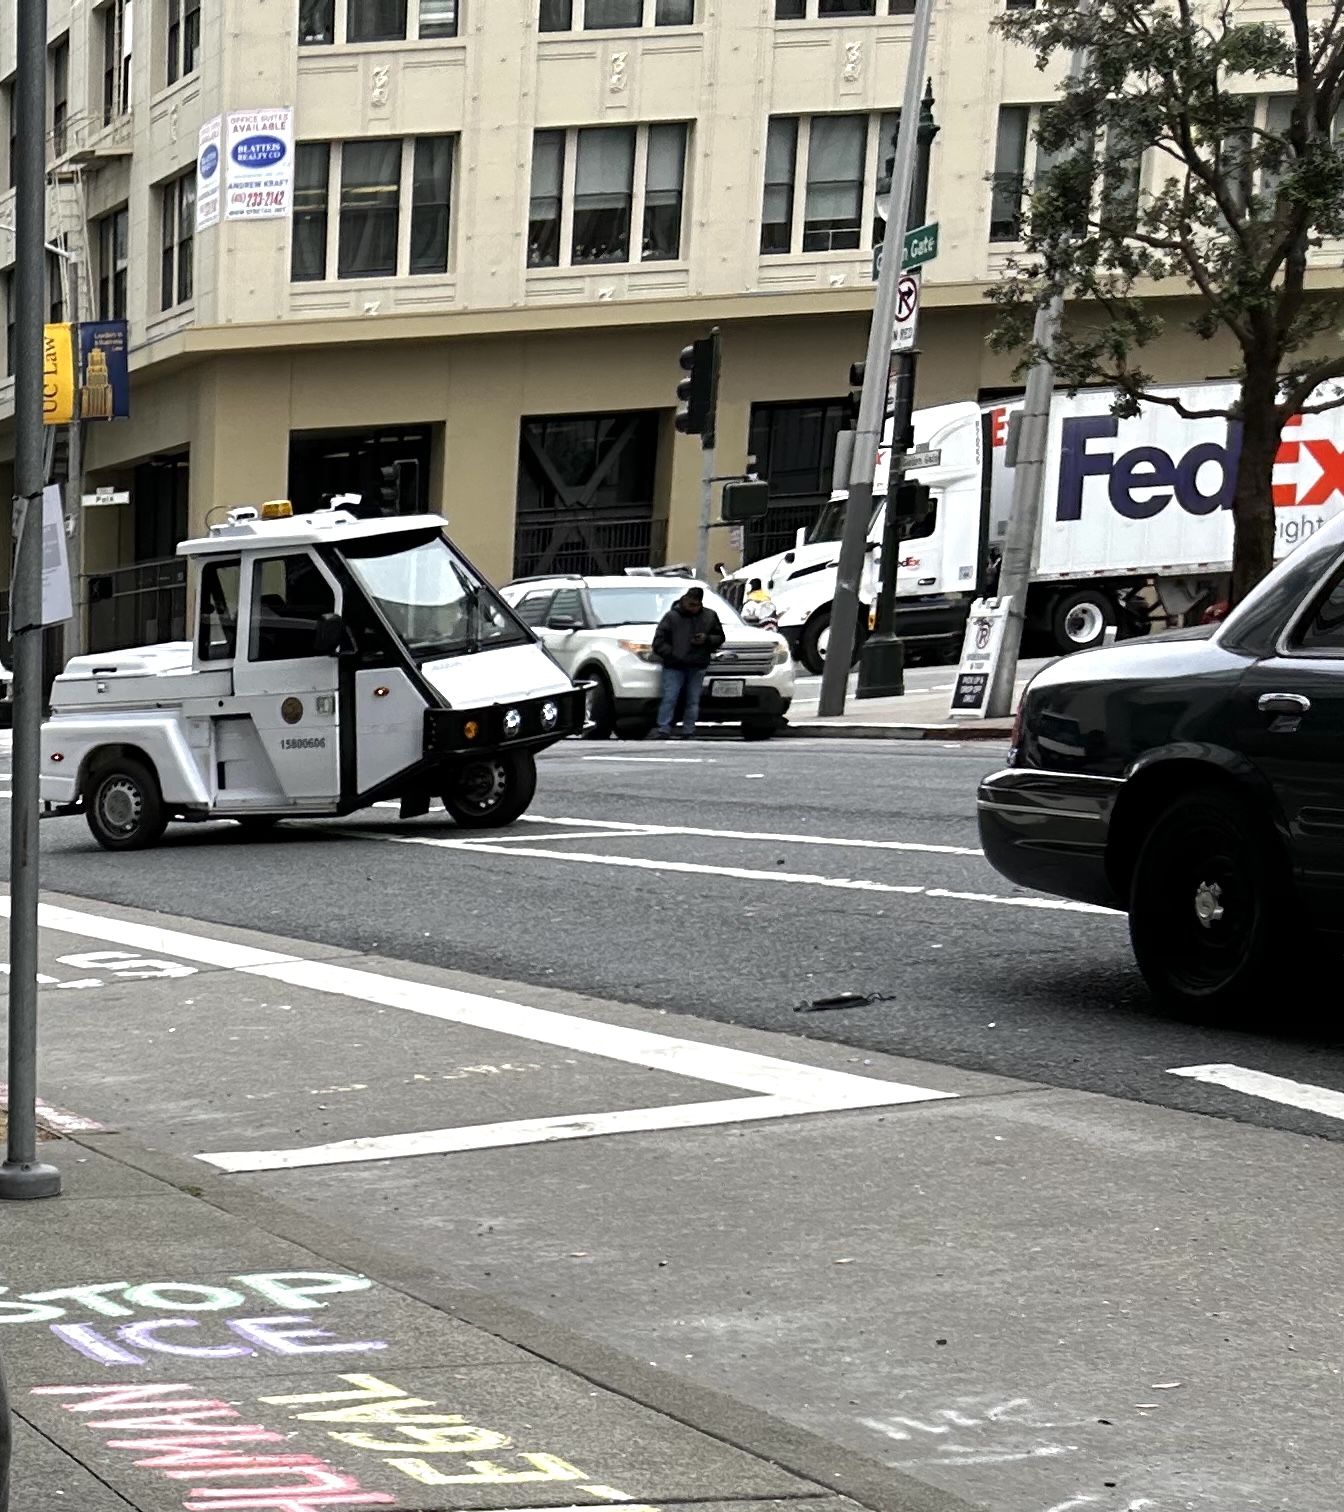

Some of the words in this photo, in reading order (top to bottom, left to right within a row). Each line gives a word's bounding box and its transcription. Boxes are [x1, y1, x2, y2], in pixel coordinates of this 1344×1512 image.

[232, 121, 286, 133] AVAILABLE
[911, 235, 935, 259] Gate
[43, 336, 58, 376] Law
[43, 383, 59, 414] UC
[48, 1315, 389, 1367] ICE
